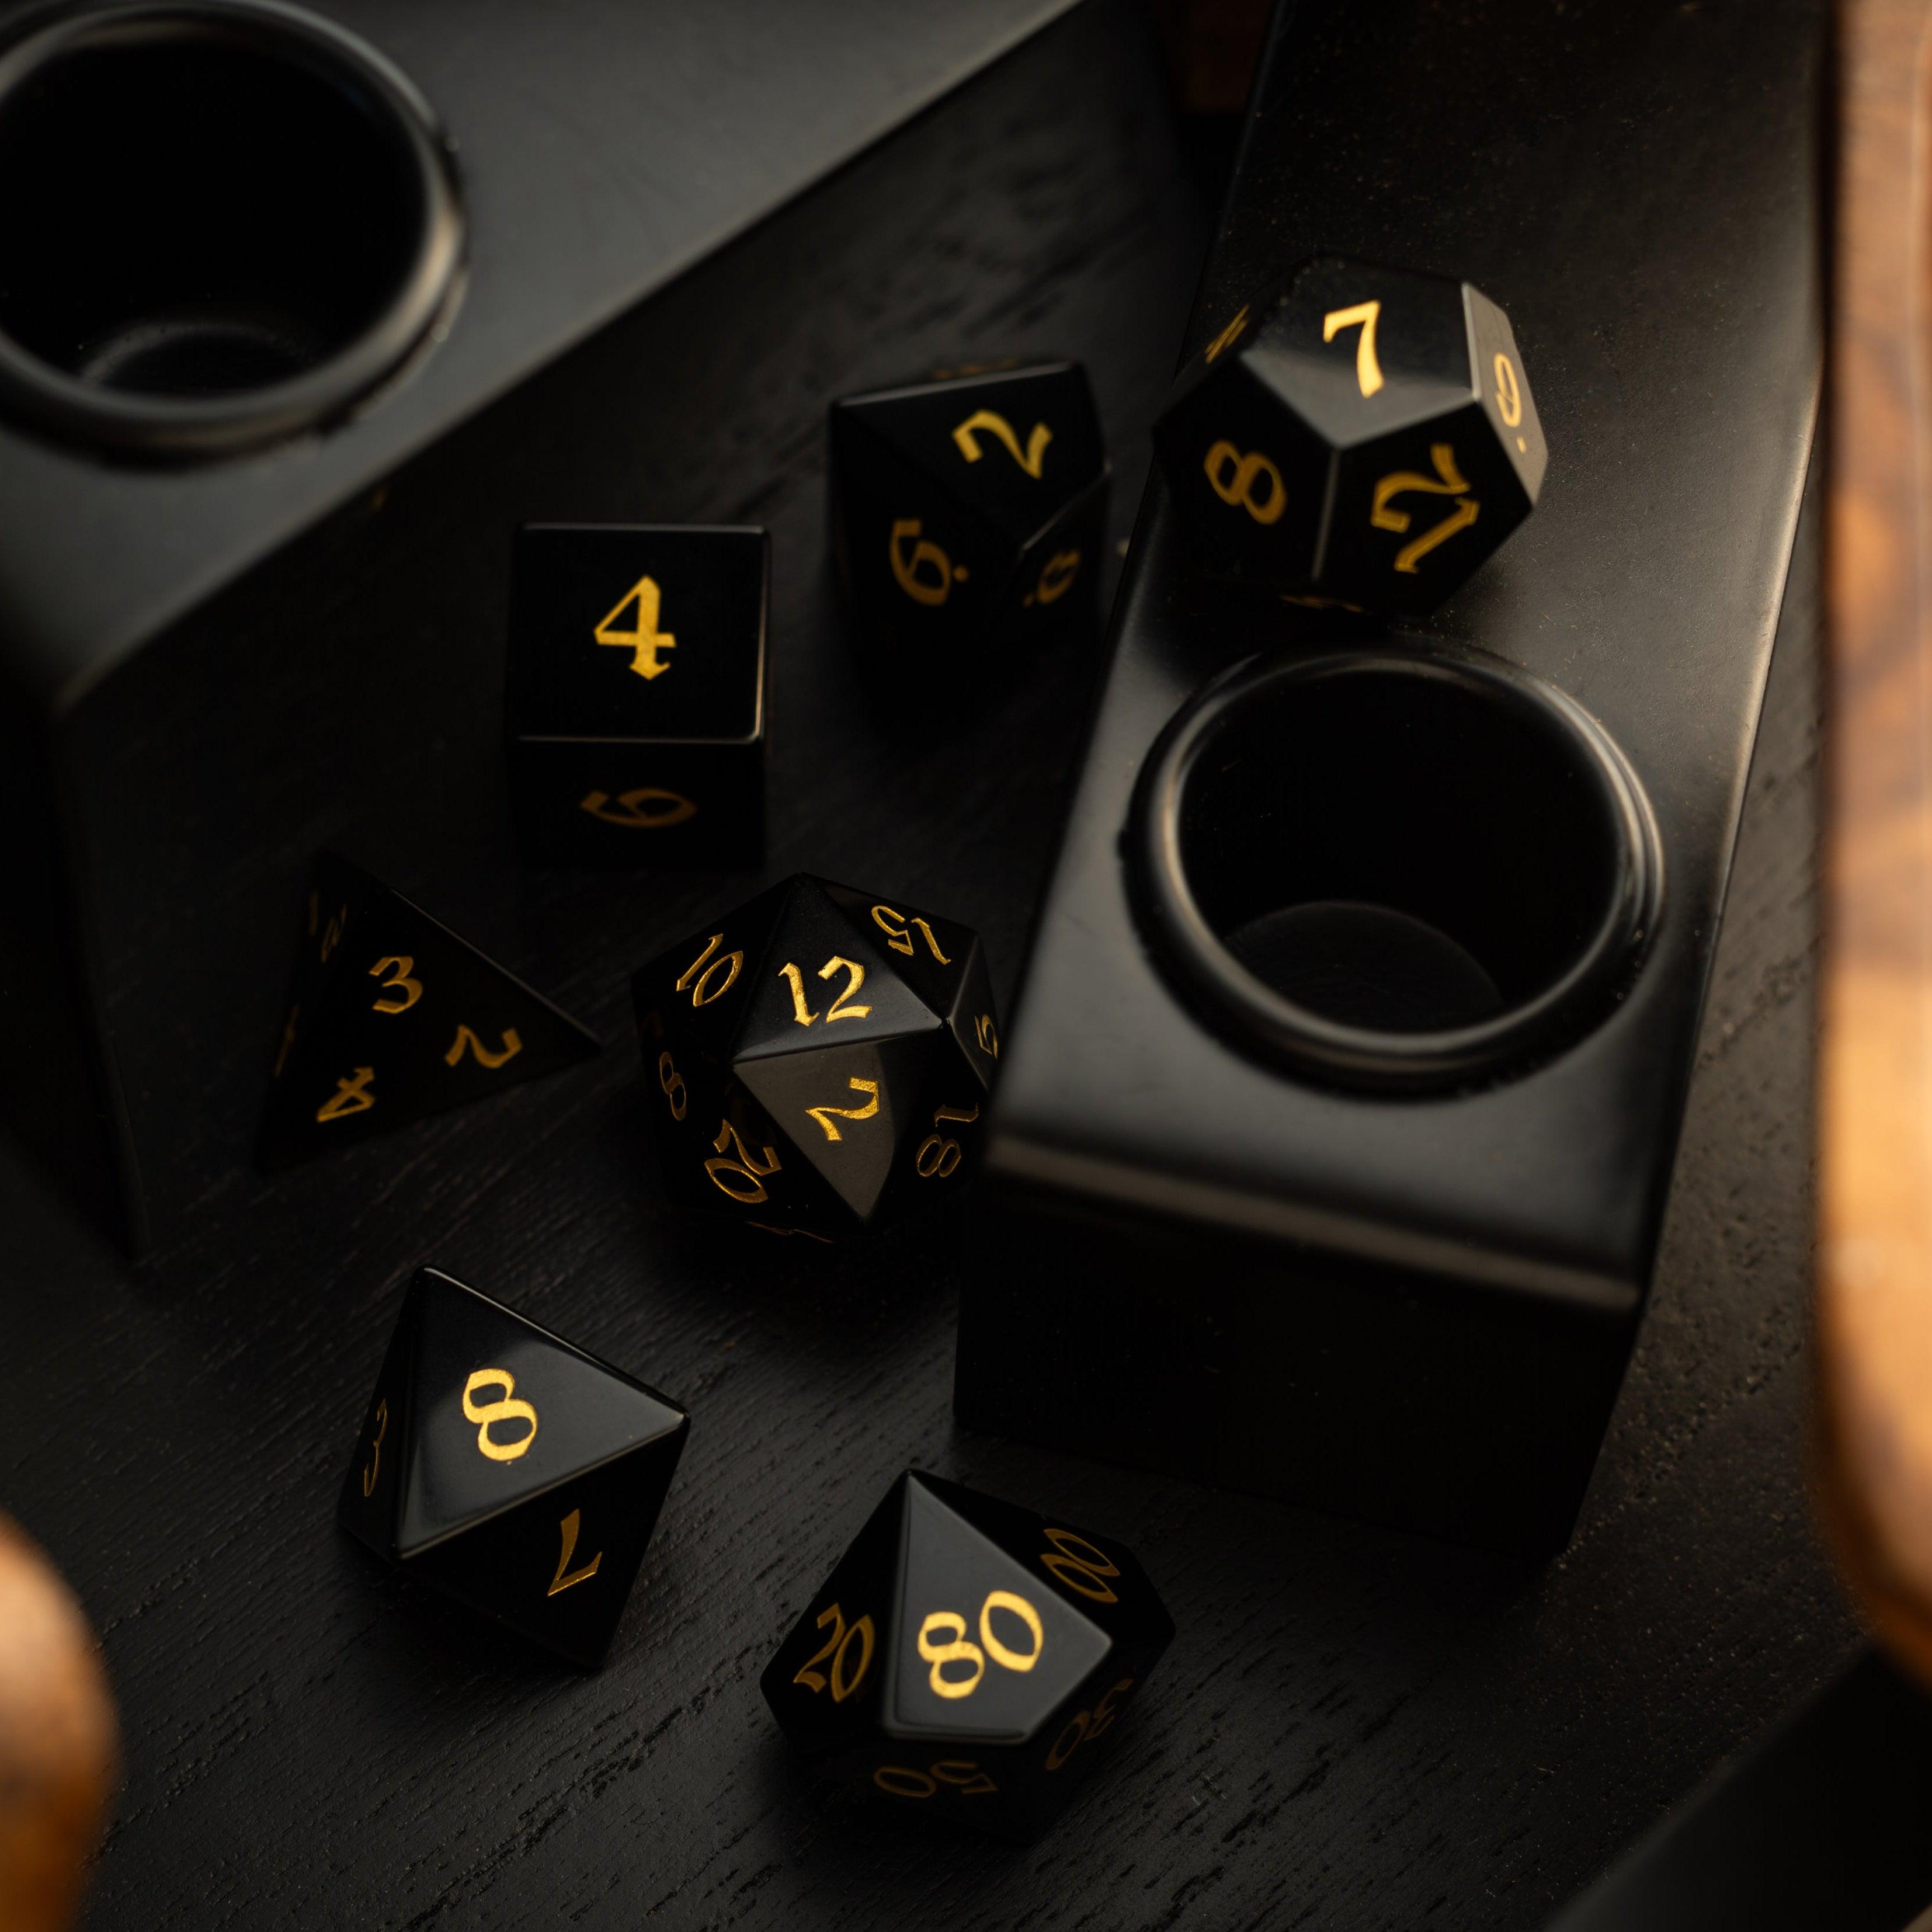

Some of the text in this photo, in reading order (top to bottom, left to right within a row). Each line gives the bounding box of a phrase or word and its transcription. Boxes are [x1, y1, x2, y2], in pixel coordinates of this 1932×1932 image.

[1322, 299, 1385, 399] 7
[952, 409, 1052, 478] 2
[1203, 440, 1287, 524] 8
[1370, 443, 1481, 574] 12
[593, 575, 677, 681] 4
[579, 787, 697, 828] 6
[675, 933, 743, 1008] 10
[870, 905, 951, 966] 15
[369, 955, 423, 1015] 3
[777, 955, 874, 1027] 12
[444, 1024, 523, 1069] 2
[974, 1013, 999, 1058] 5
[315, 1065, 378, 1123] 4
[658, 1051, 688, 1122] 8
[805, 1076, 880, 1142] 2
[703, 1118, 782, 1204] 20
[915, 1102, 980, 1179] 18
[461, 1367, 539, 1464] 8
[546, 1508, 603, 1598] 7
[1039, 1527, 1121, 1604] 00
[792, 1602, 875, 1703] 20
[916, 1589, 1045, 1700] 80
[871, 1758, 999, 1799] 50
